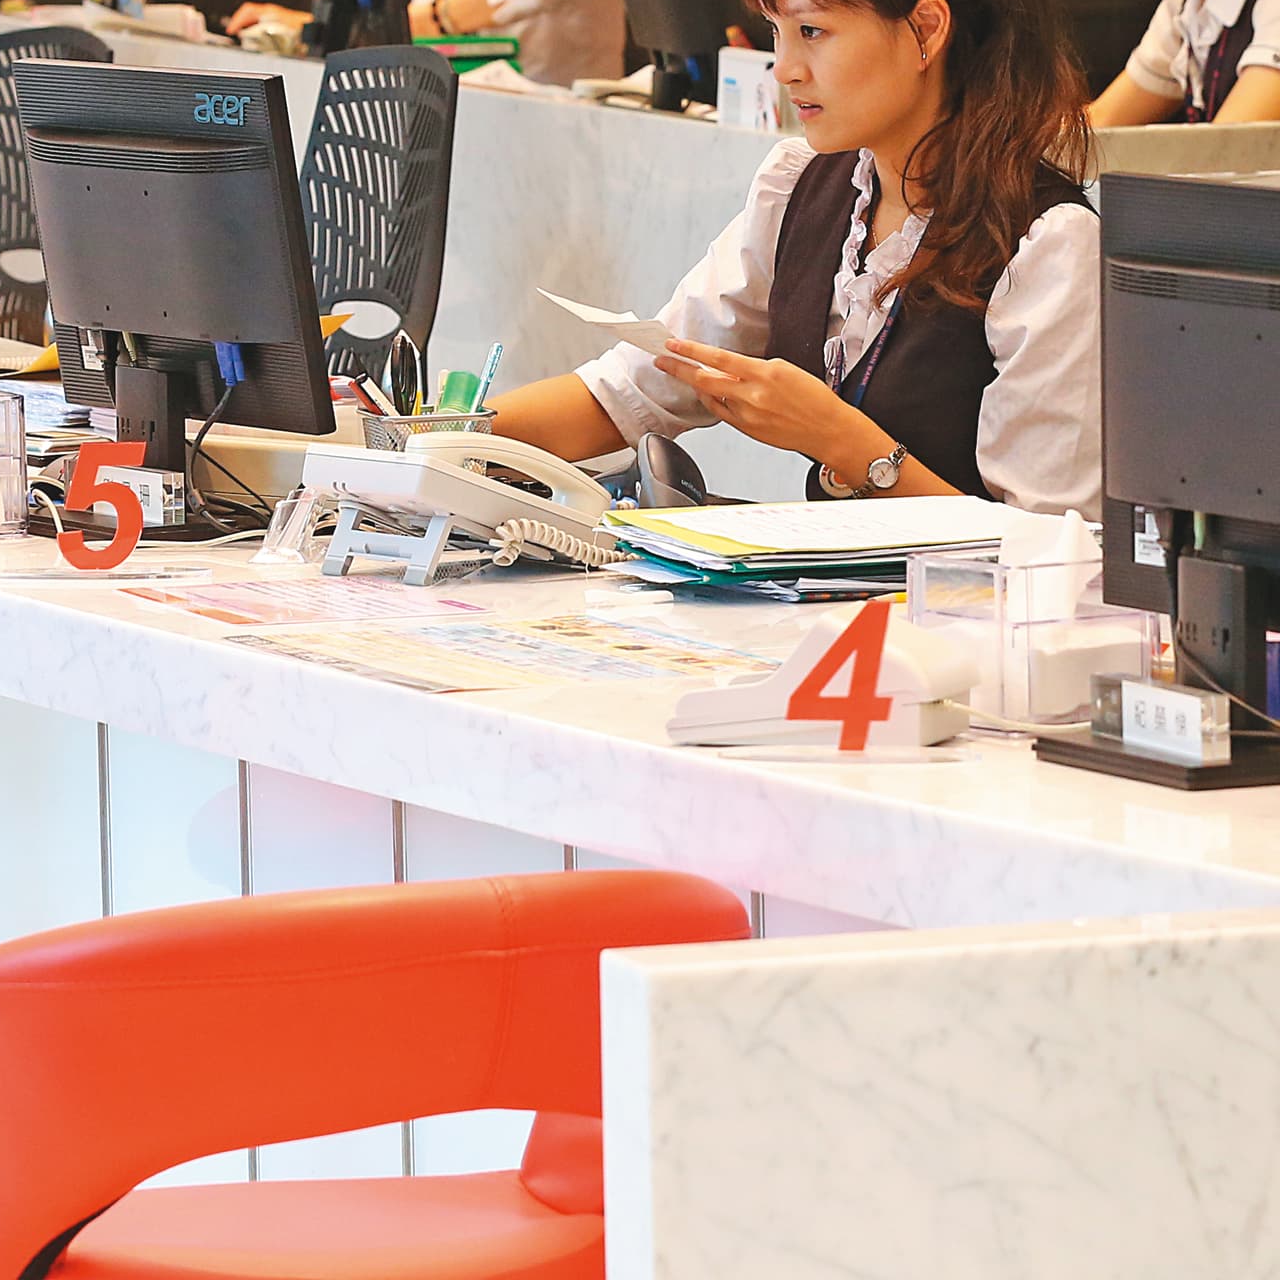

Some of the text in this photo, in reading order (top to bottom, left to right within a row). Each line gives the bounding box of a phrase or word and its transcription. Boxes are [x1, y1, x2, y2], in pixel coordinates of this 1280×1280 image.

[194, 93, 251, 126] acer
[57, 441, 147, 571] 5
[785, 598, 894, 751] 4
